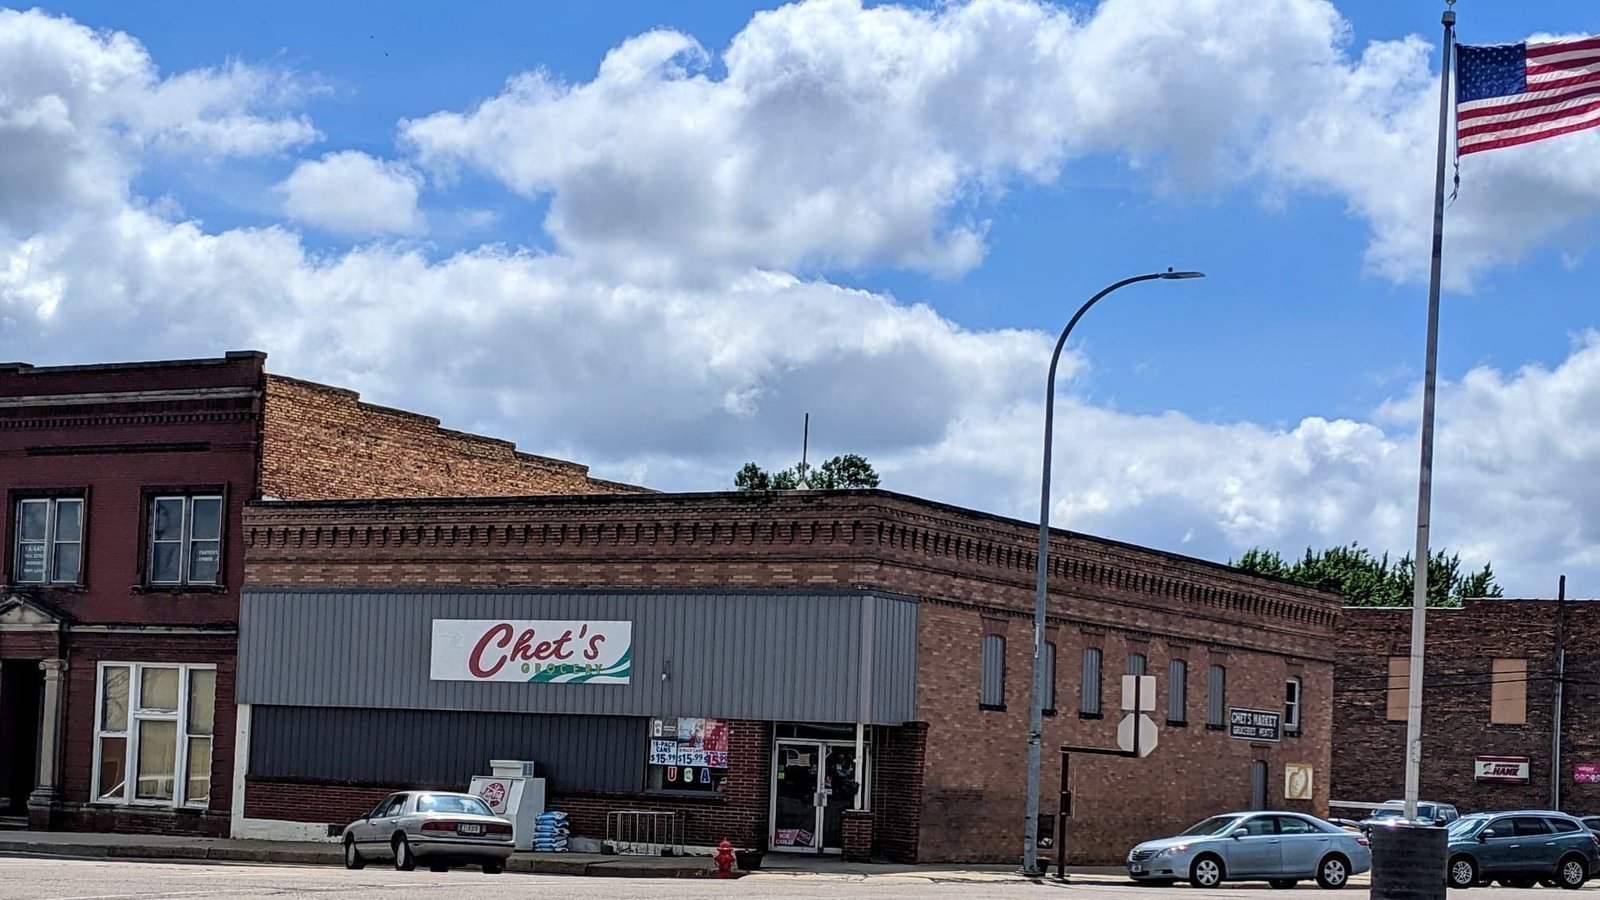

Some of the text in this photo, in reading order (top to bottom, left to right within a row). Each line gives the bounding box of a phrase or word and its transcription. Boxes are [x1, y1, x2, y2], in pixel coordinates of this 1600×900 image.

[469, 623, 606, 678] Chet's
[521, 663, 603, 674] GROCERY
[1253, 713, 1278, 727] MARKET
